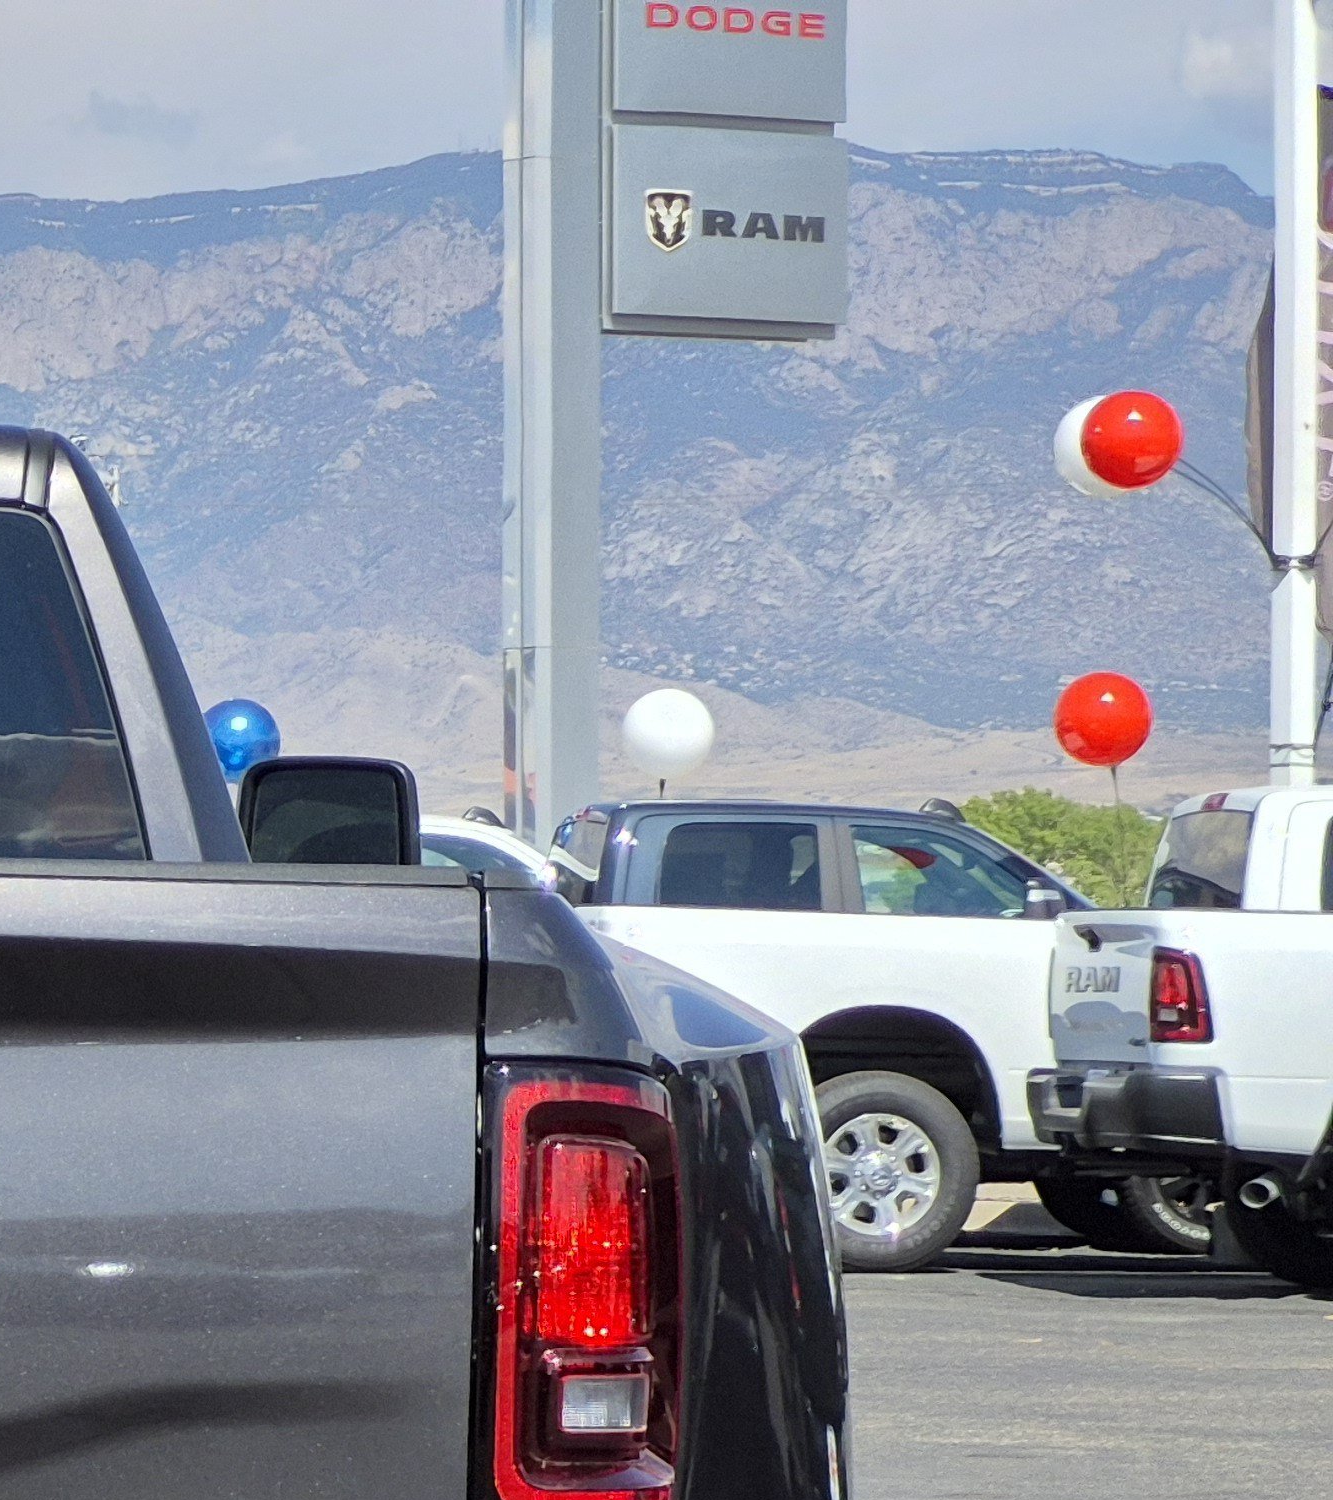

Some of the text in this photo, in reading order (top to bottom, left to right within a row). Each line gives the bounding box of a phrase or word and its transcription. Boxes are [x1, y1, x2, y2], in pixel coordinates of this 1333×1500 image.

[645, 2, 827, 40] DODGE
[701, 209, 826, 244] RAM
[1065, 966, 1121, 993] RAM
